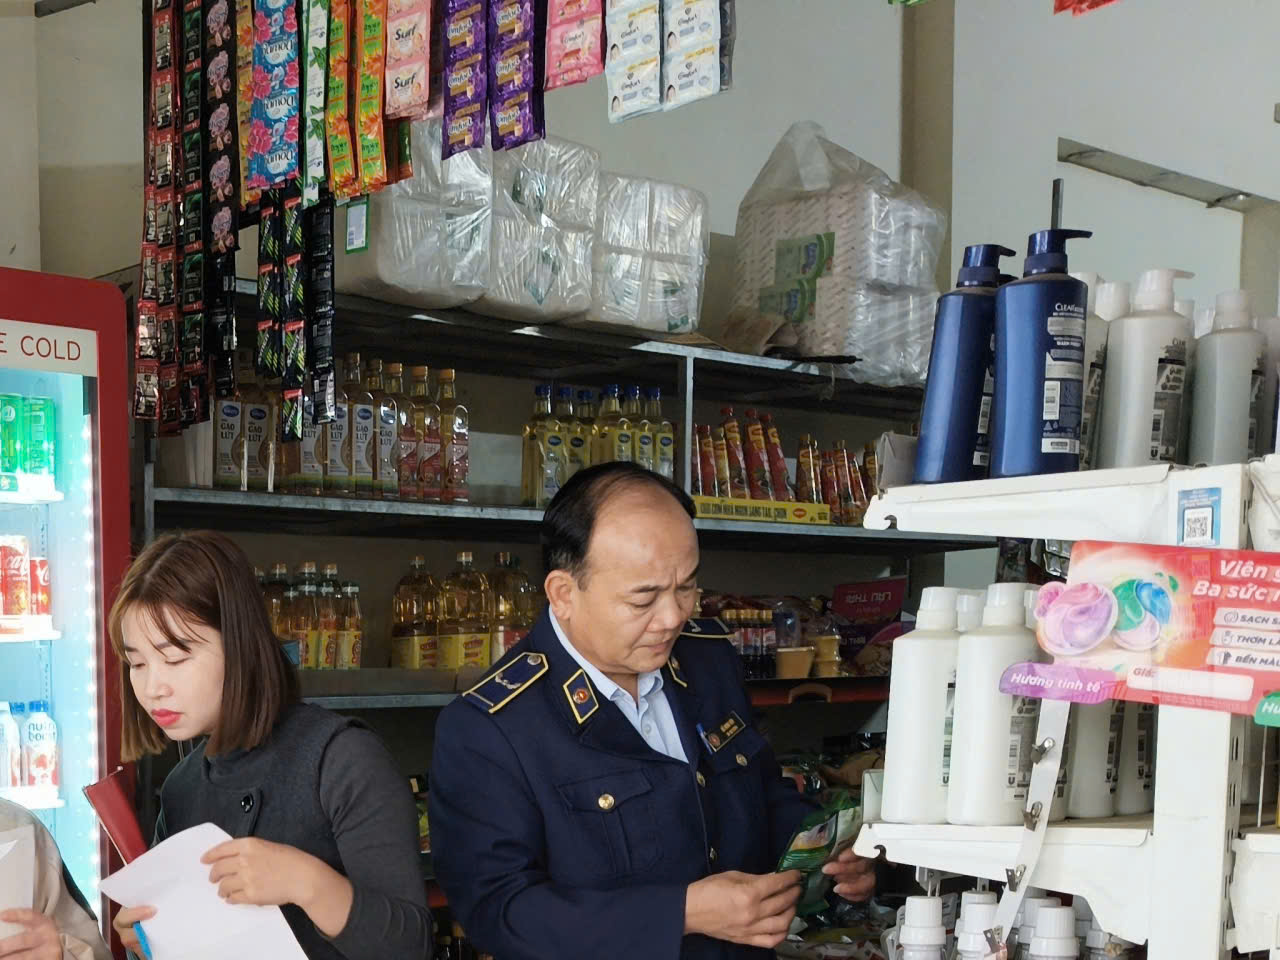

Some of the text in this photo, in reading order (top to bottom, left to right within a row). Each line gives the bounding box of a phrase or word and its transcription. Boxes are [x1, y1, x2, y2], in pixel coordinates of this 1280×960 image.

[394, 27, 416, 41] Surf
[394, 73, 416, 88] Surf
[20, 334, 81, 362] COLD
[1219, 559, 1269, 580] Viên
[1192, 580, 1269, 601] Ba sức
[1010, 672, 1054, 689] Hương
